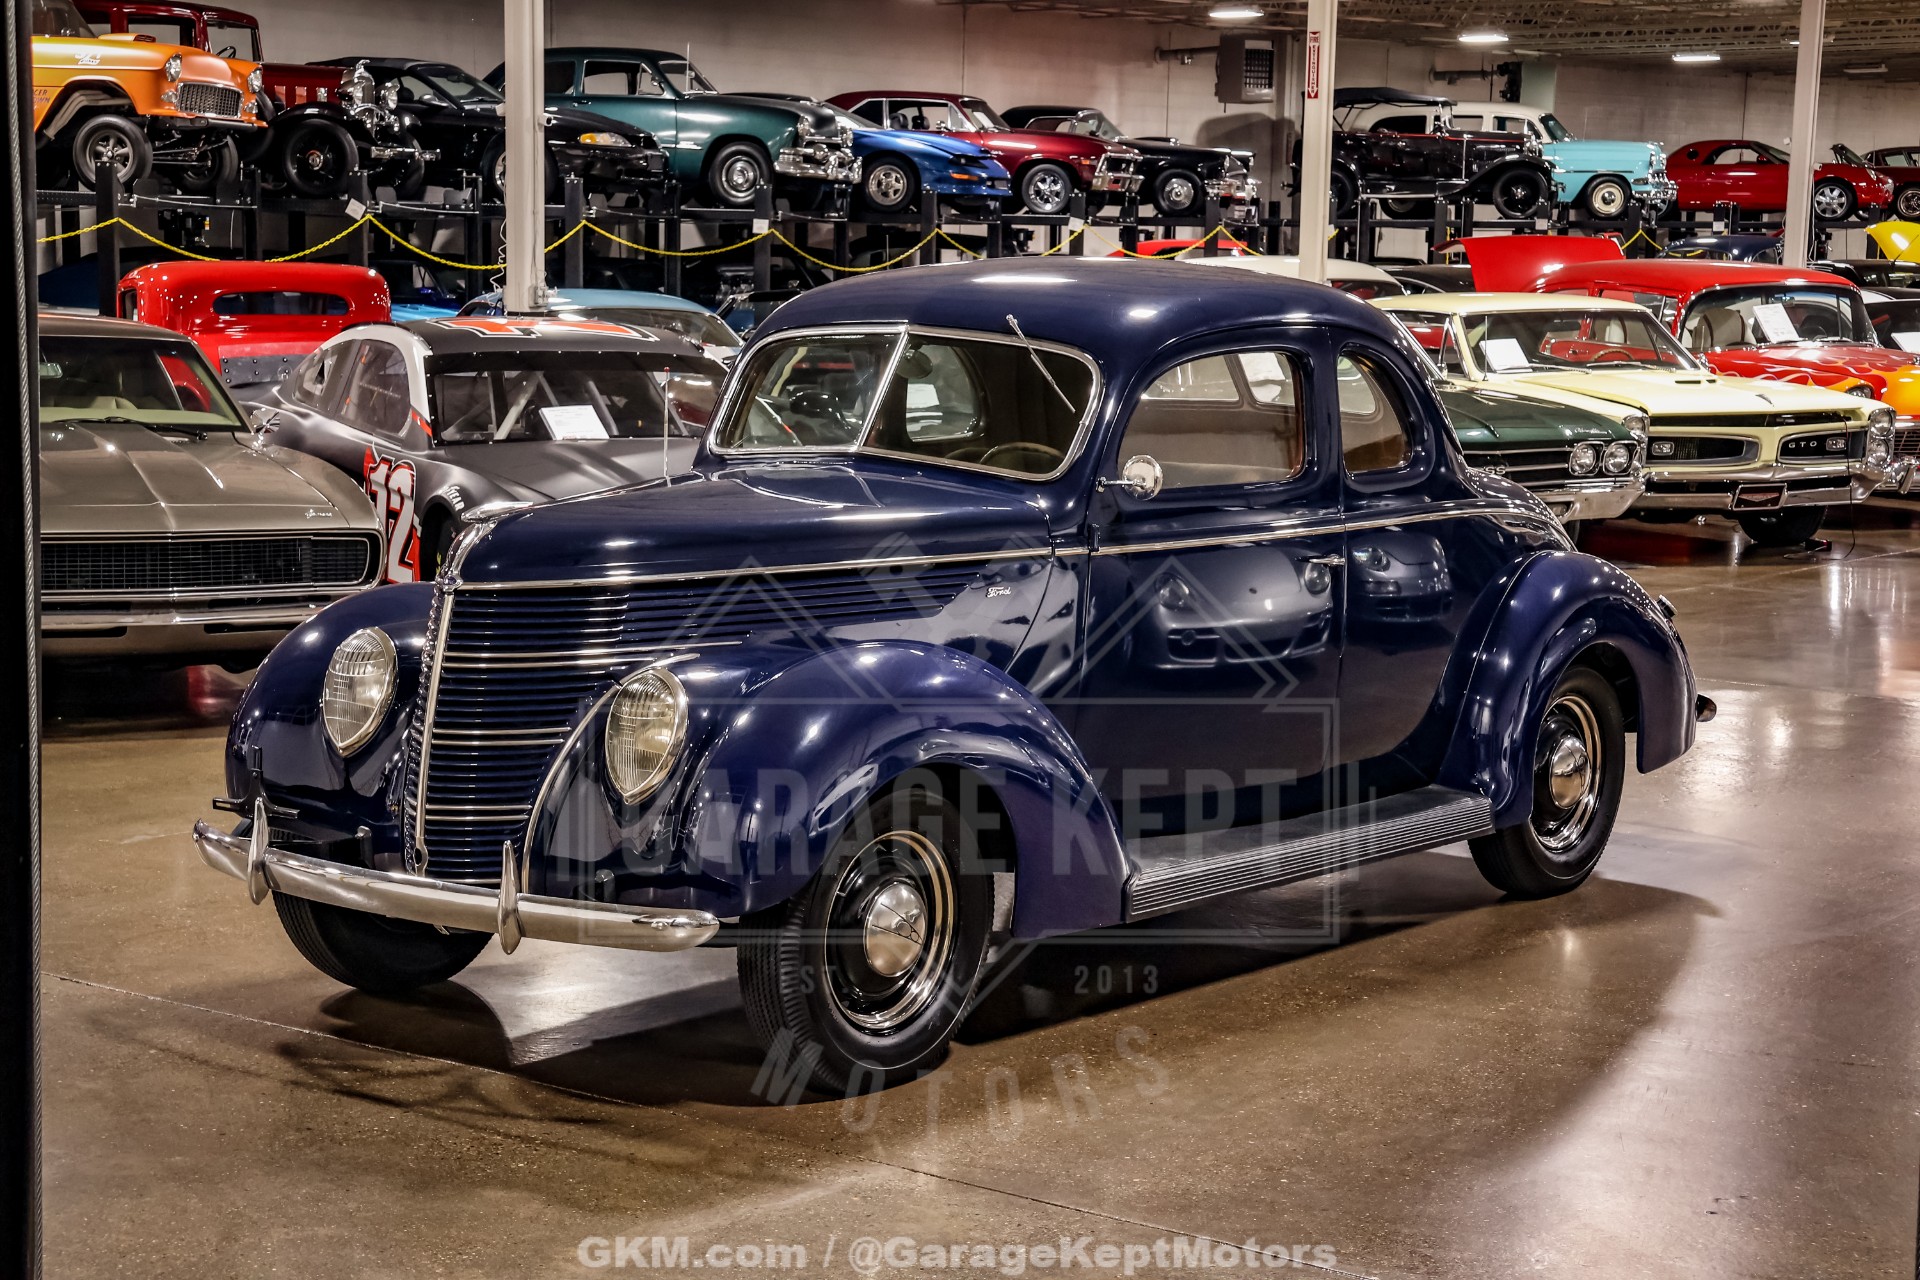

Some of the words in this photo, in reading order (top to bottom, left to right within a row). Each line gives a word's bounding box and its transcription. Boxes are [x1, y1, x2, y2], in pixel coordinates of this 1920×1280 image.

[1788, 440, 1818, 449] GTO
[367, 455, 416, 584] 12
[987, 586, 1012, 598] Ford
